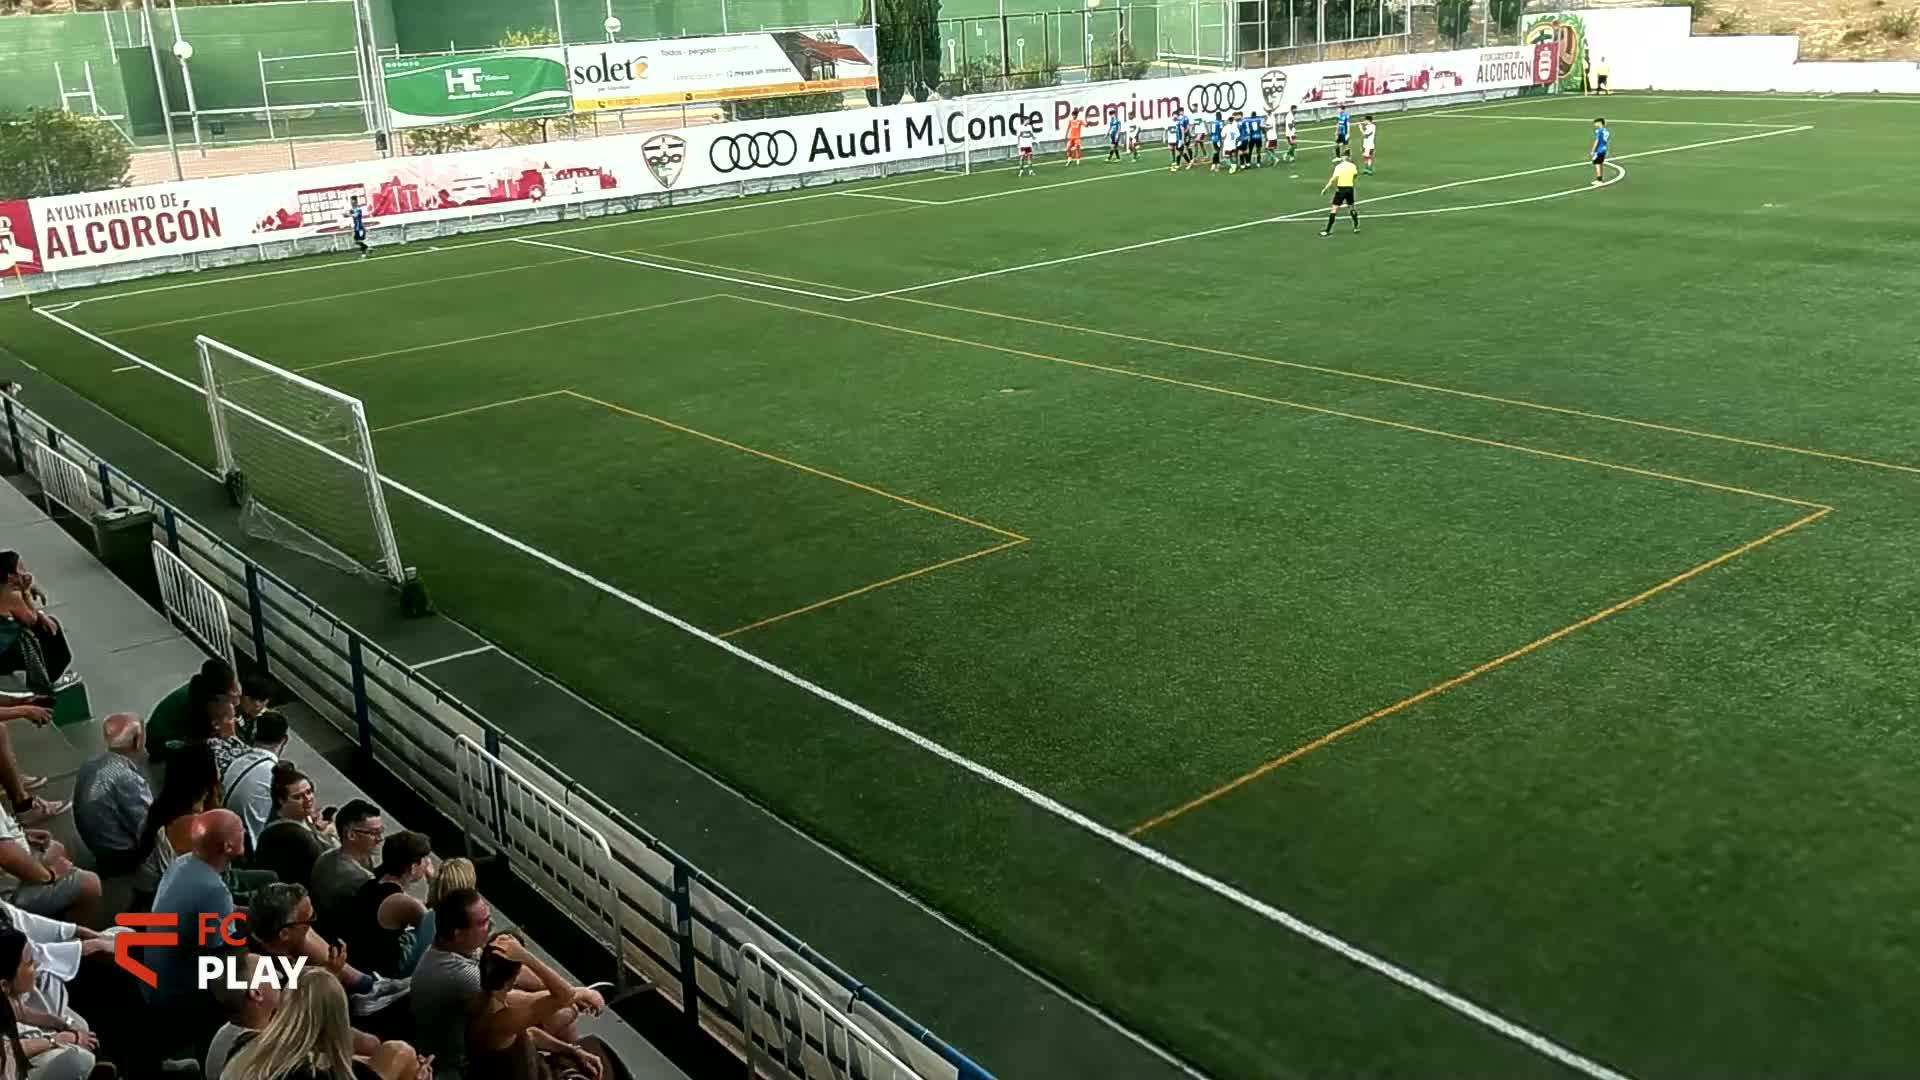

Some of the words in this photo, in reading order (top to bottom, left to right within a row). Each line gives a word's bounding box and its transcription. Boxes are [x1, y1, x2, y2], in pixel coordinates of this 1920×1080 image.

[808, 119, 891, 163] Audi
[905, 102, 1043, 149] M.Conde
[46, 195, 156, 223] AYUNTAMIENTO
[160, 193, 178, 208] DE
[46, 199, 222, 260] ALCORCÓN
